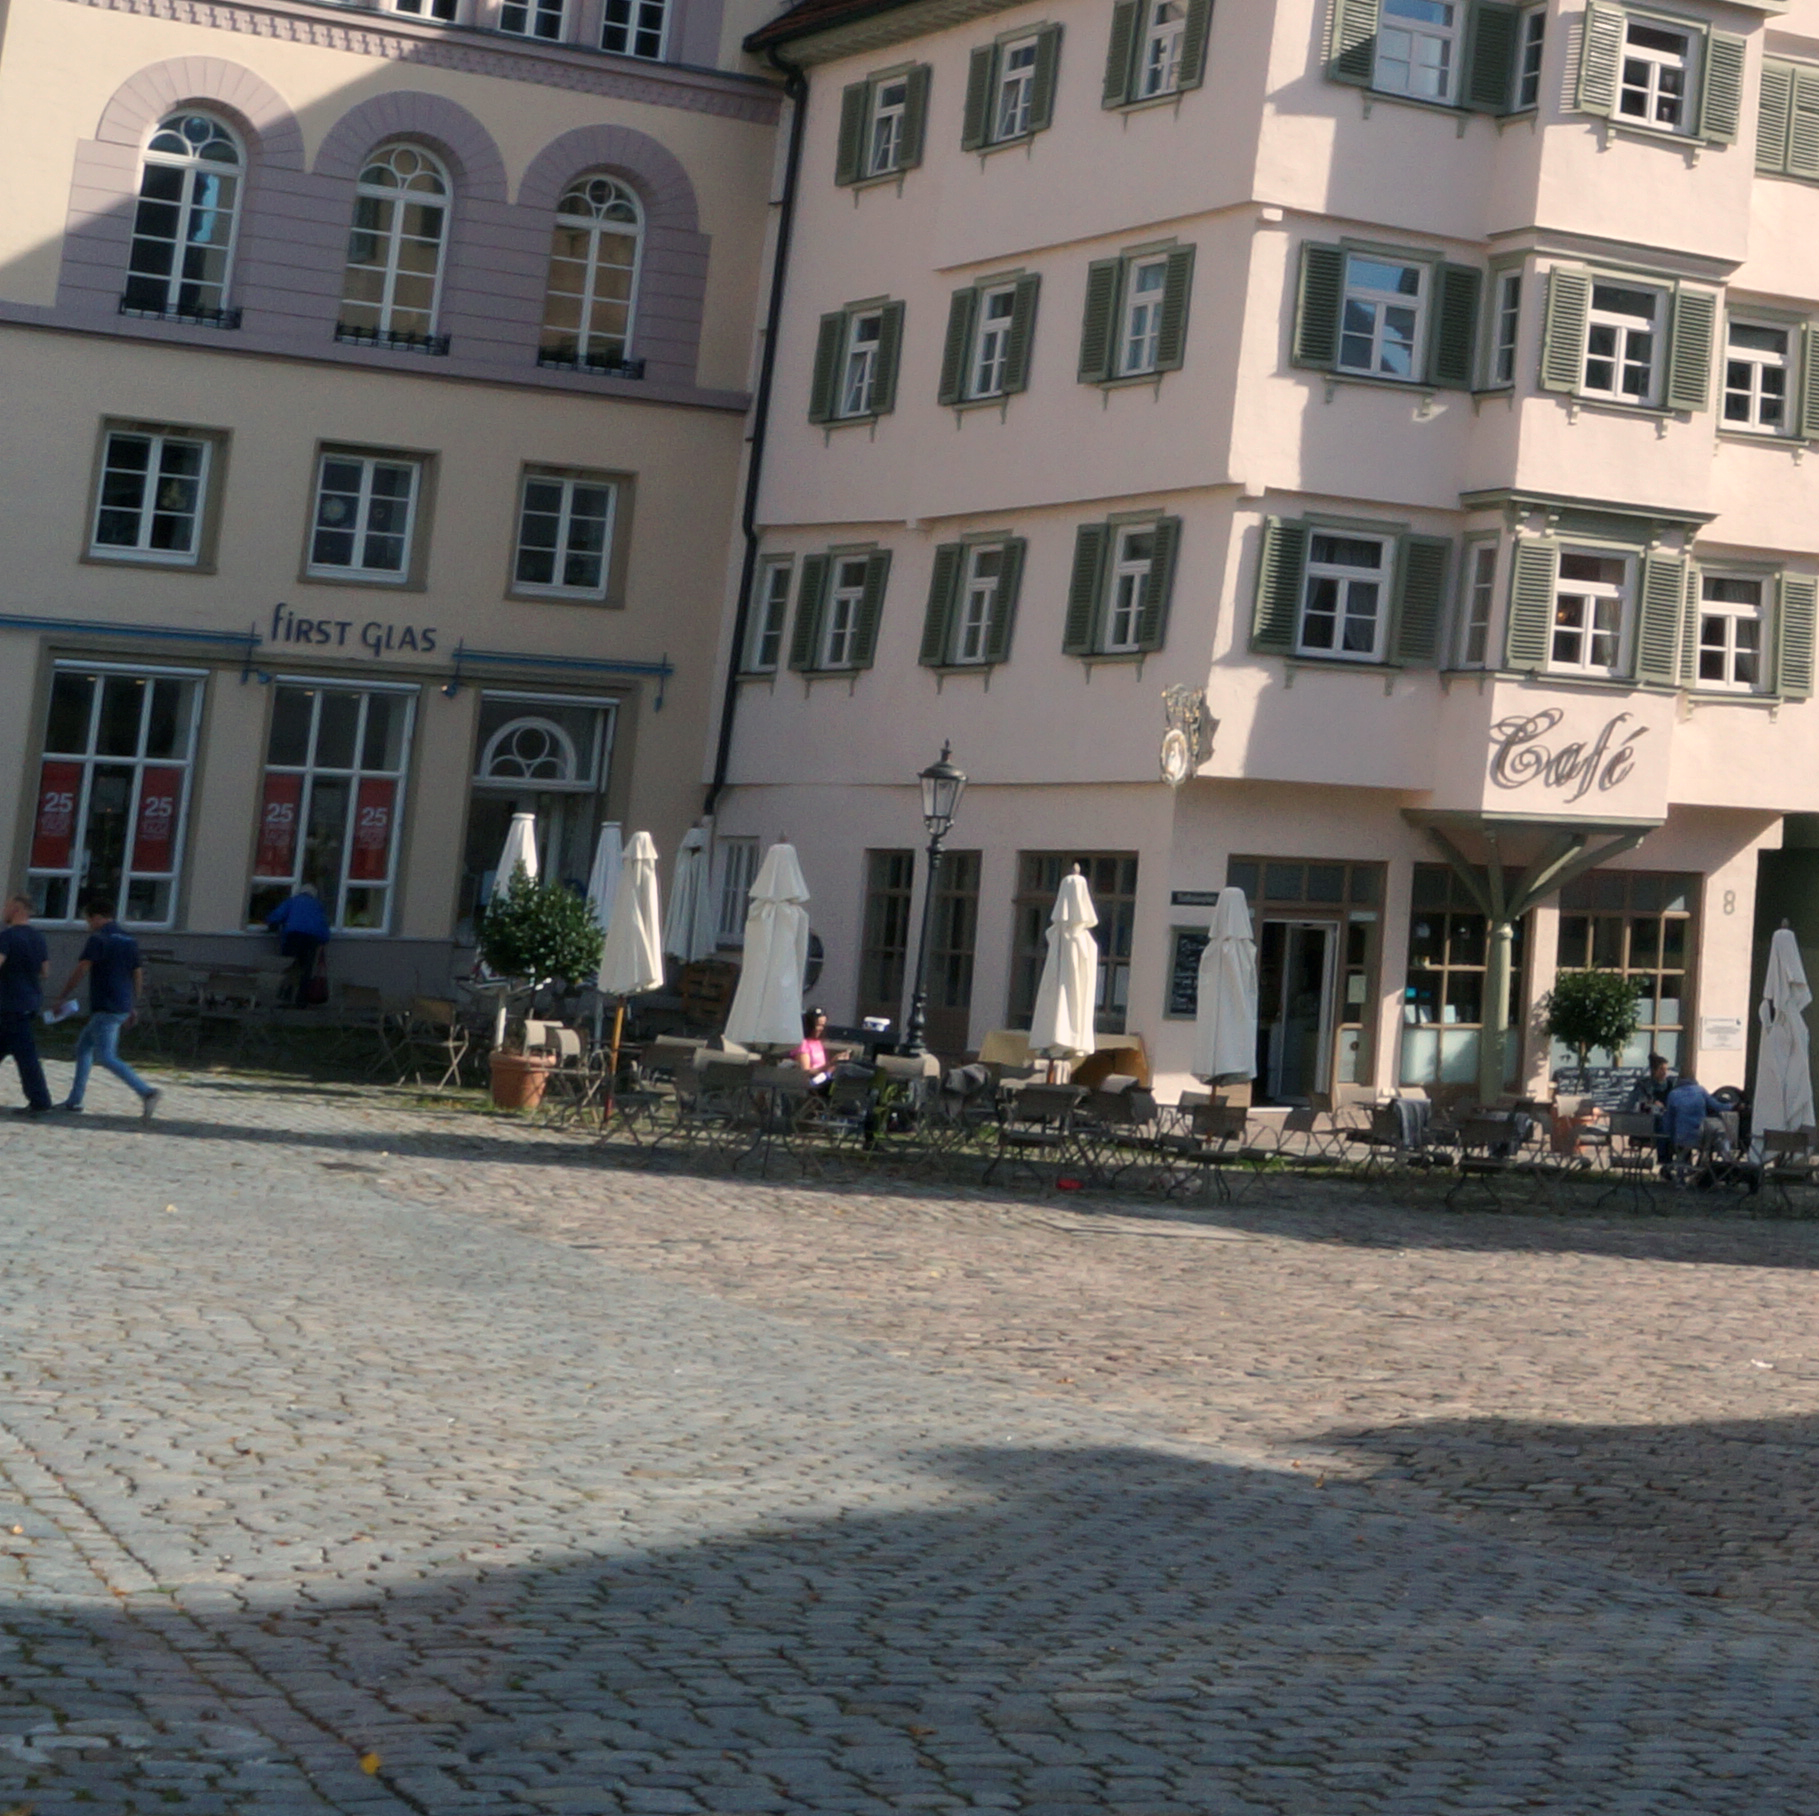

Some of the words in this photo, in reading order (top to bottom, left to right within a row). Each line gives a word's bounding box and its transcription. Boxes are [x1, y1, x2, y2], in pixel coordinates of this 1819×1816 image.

[1489, 707, 1650, 804] Café
[43, 791, 74, 814] 25
[144, 796, 173, 818] 25
[265, 802, 295, 824] 25
[360, 806, 388, 828] 25
[1722, 889, 1736, 916] 8
